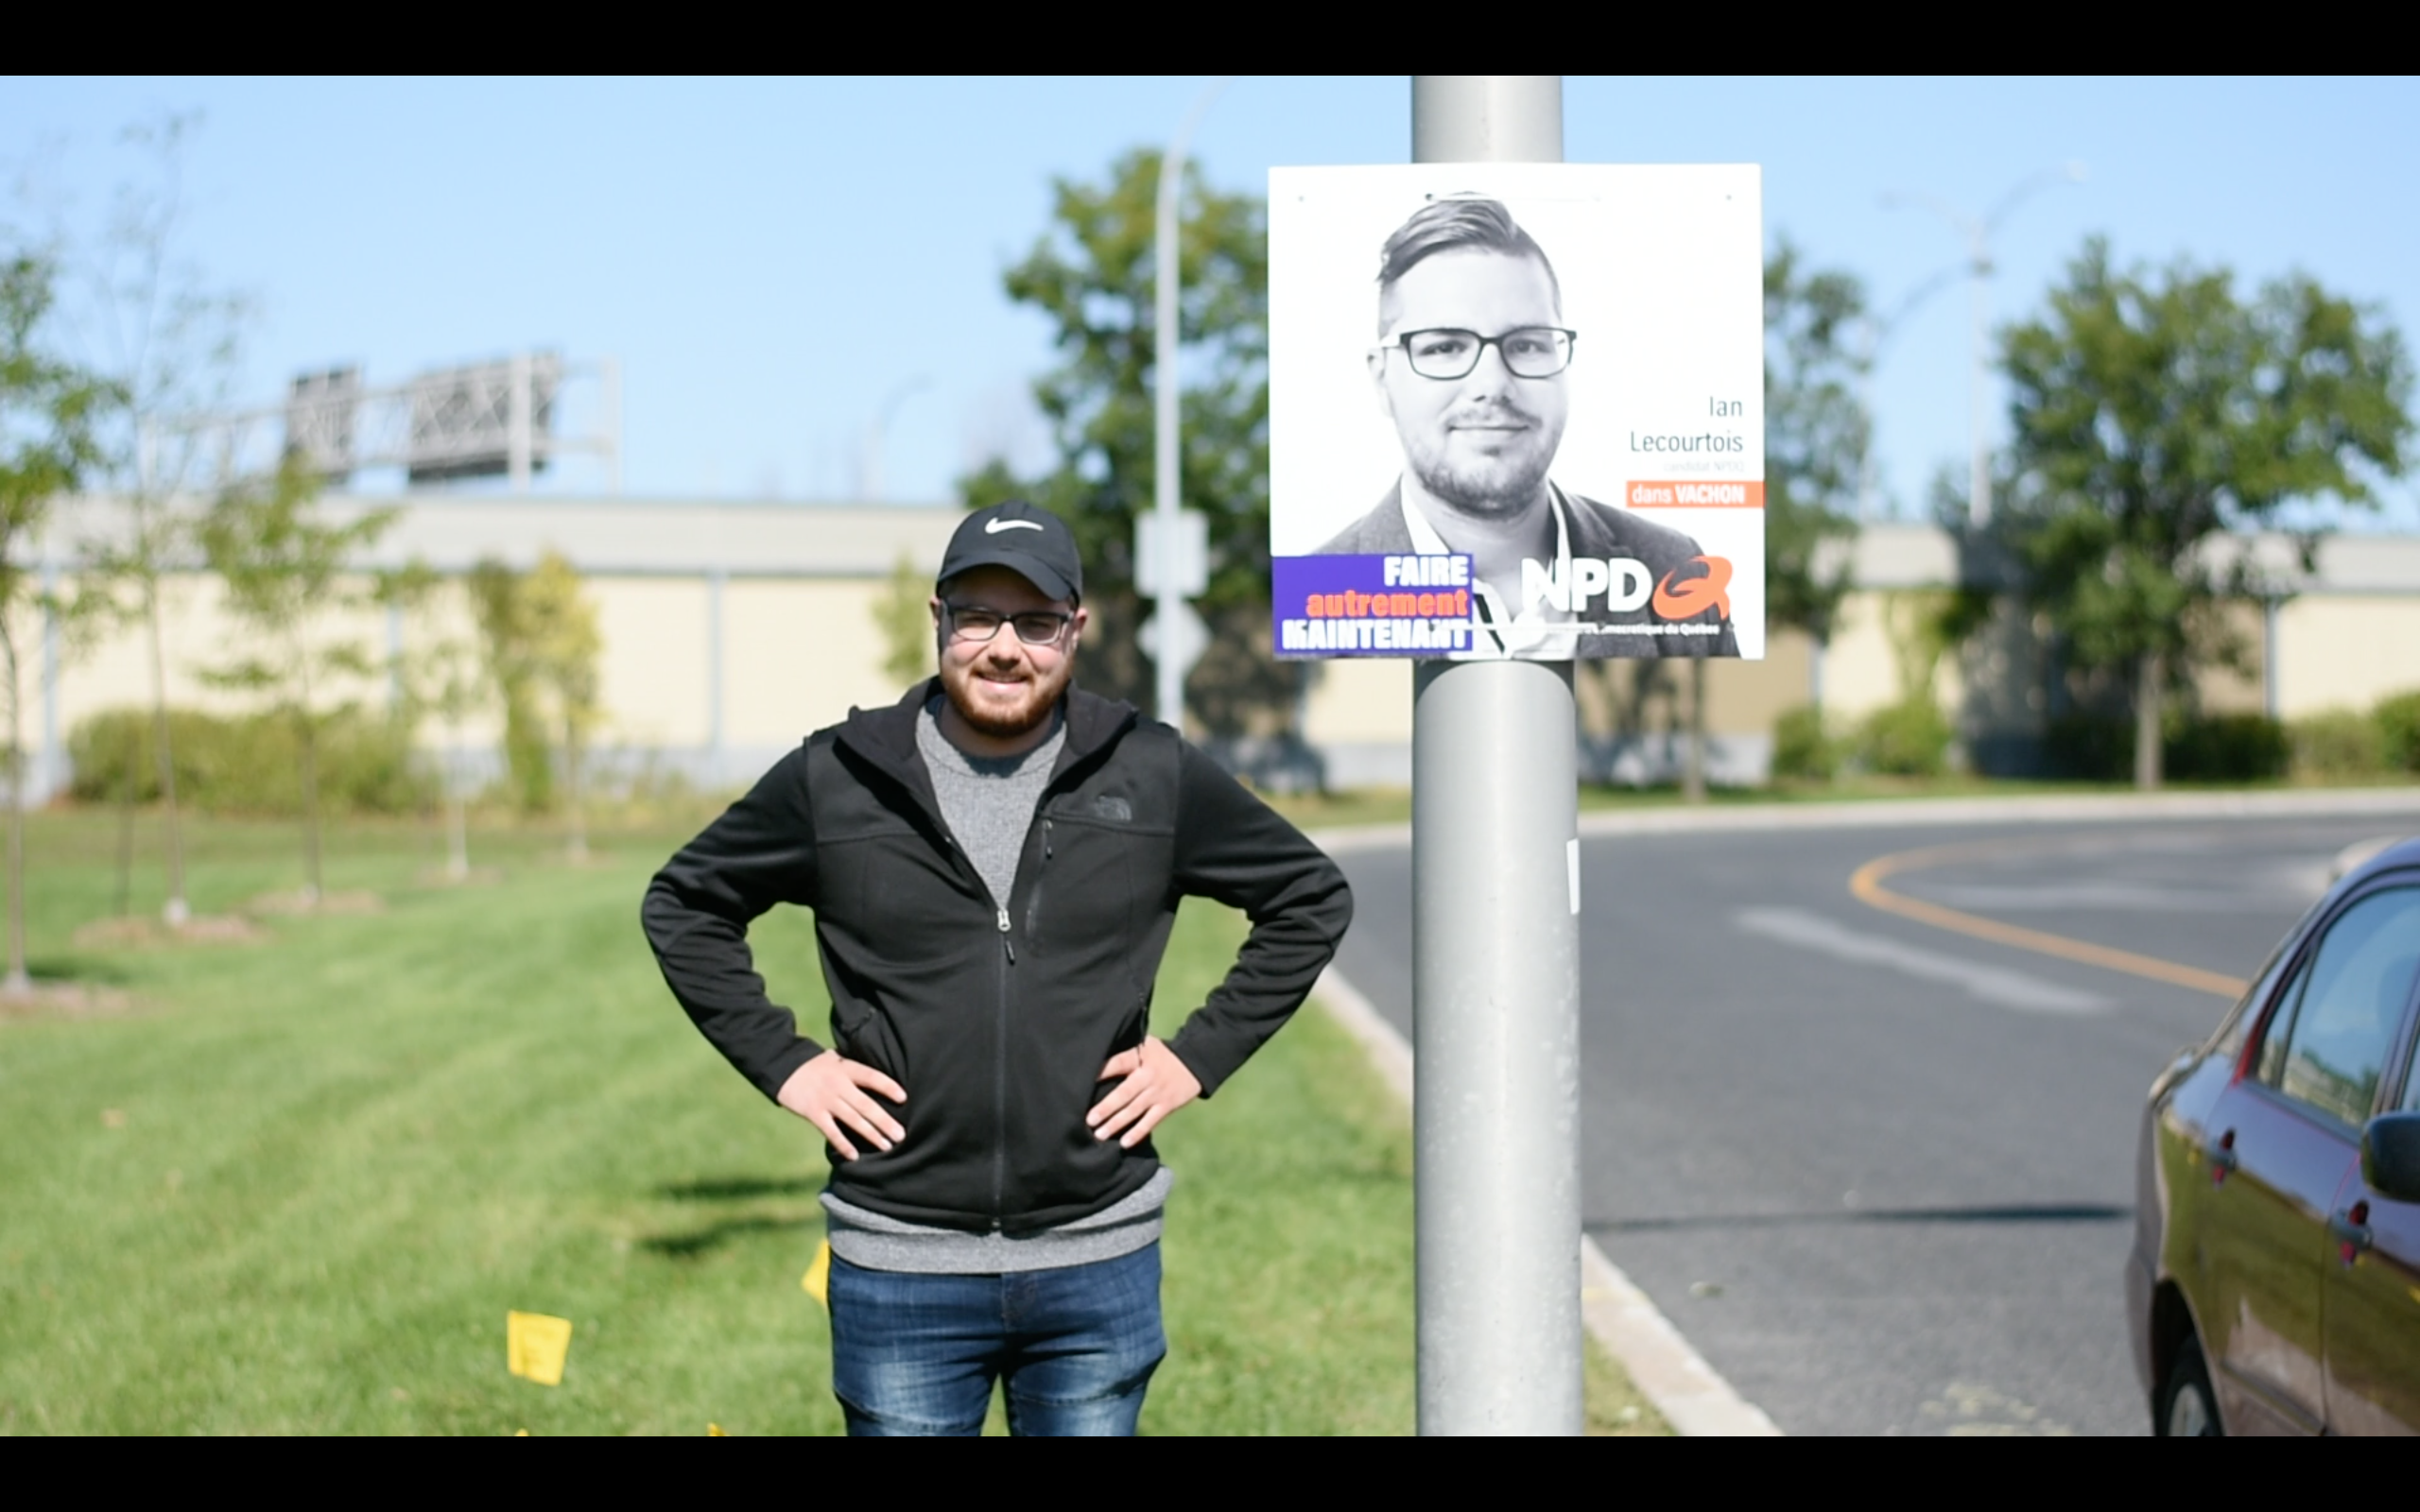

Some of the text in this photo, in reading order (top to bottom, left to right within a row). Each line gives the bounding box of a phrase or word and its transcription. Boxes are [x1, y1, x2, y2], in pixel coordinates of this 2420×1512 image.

[1709, 395, 1742, 417] Ian
[1630, 430, 1743, 453] Lecourtois
[1632, 484, 1745, 505] dans VACHON
[1383, 555, 1470, 587] FAIRE
[1305, 588, 1469, 618] autrement
[1281, 618, 1471, 650] MAINTENANT
[1665, 623, 1679, 635] du
